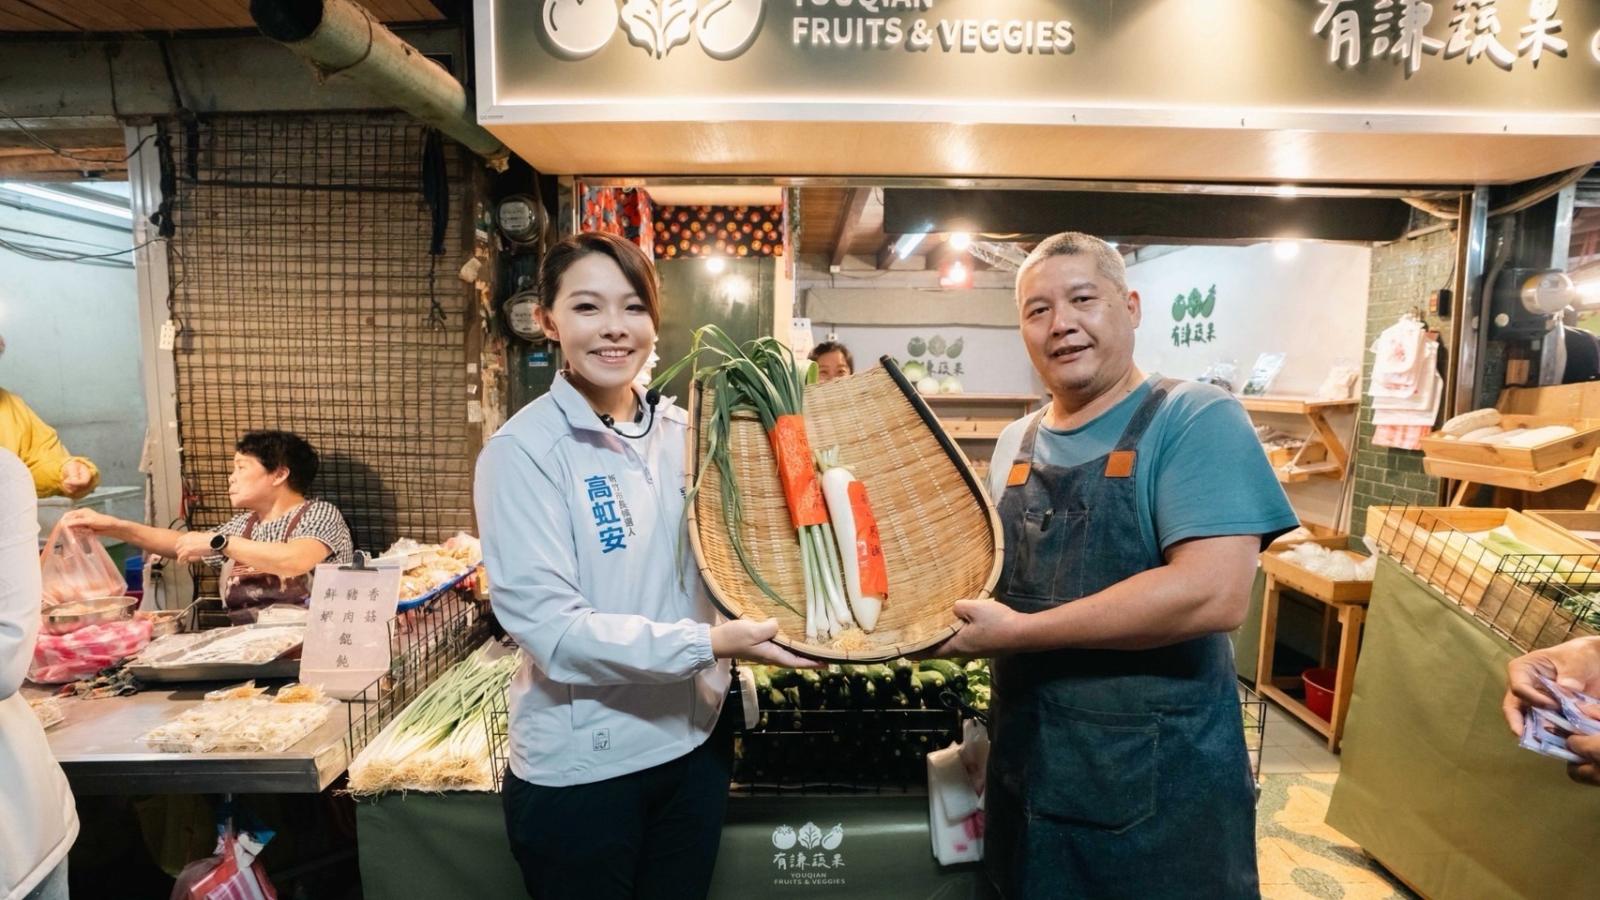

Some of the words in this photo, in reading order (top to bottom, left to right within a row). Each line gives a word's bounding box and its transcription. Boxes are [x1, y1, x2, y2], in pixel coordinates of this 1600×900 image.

[793, 17, 904, 45] FRUITS
[910, 19, 934, 46] &
[938, 18, 1074, 49] VEGGIES
[584, 475, 627, 554] 高虹安
[773, 852, 846, 870] 有謙蔬果
